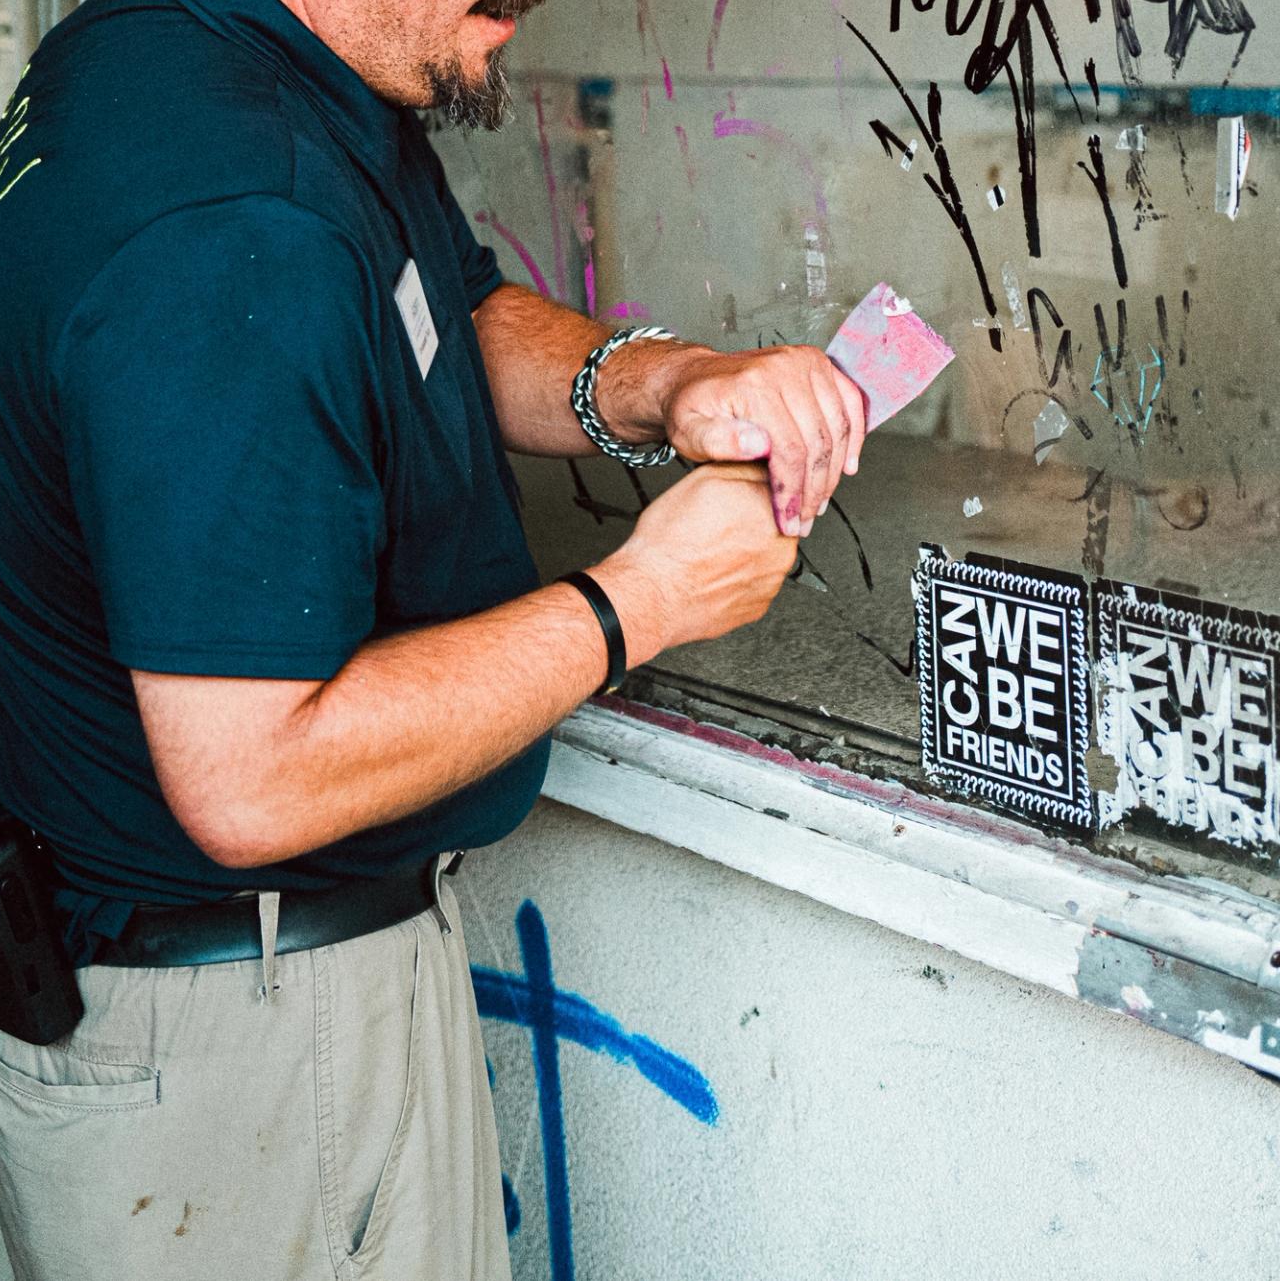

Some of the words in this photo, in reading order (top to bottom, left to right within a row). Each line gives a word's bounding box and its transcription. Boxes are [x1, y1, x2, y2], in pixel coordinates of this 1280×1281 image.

[941, 589, 980, 727] CAN
[974, 595, 1062, 675] WE
[987, 665, 1058, 743] BE
[1126, 631, 1171, 779] CAN
[1167, 639, 1270, 728] WE
[946, 724, 1064, 788] FRIENDS
[1181, 715, 1262, 799] BE
